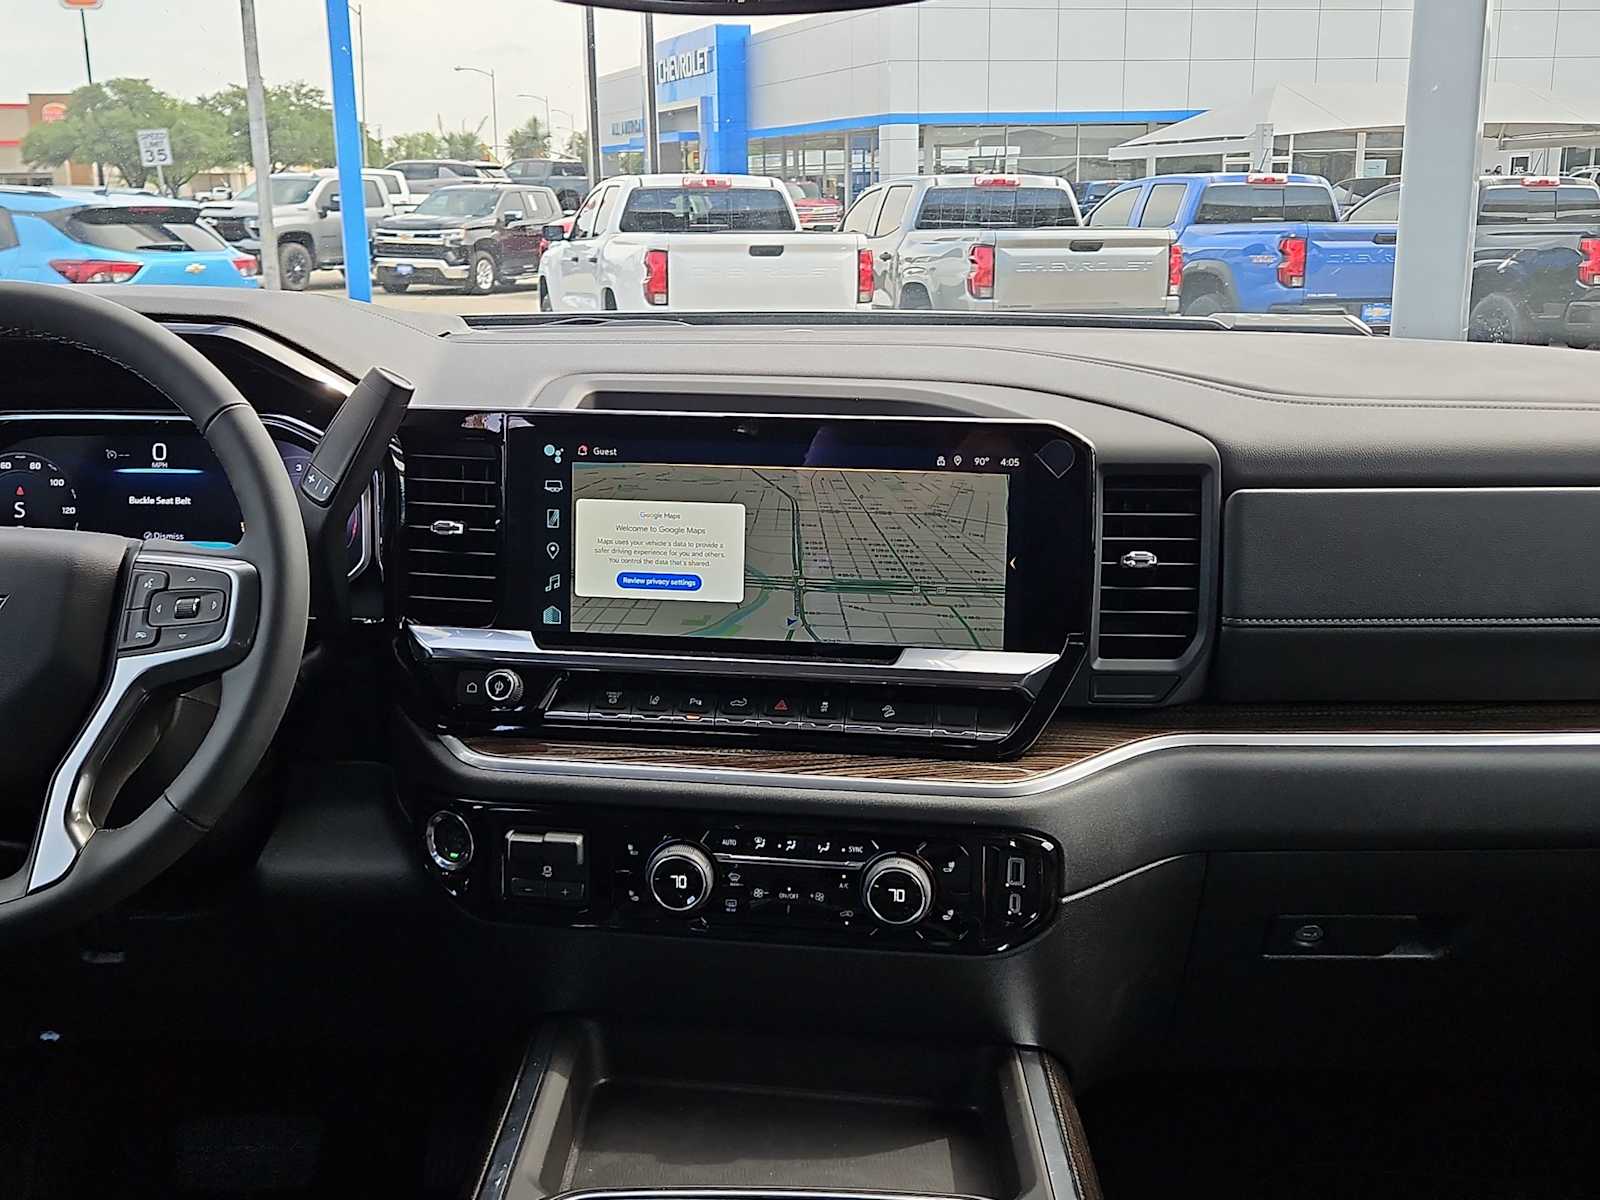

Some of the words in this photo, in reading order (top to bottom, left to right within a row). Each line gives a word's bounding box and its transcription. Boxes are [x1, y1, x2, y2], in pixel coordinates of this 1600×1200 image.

[657, 48, 708, 84] CHEVROLET
[145, 149, 168, 162] 35
[1015, 261, 1153, 272] CHEVROLET
[152, 443, 167, 461] 0
[593, 447, 617, 456] Guest
[30, 462, 41, 470] 80
[974, 457, 990, 466] 90°
[1000, 458, 1020, 467] 4:05
[50, 478, 64, 486] 100
[129, 496, 155, 505] Buckle
[156, 497, 173, 505] Seat
[174, 497, 191, 505] Belt
[14, 502, 26, 519] S
[640, 511, 662, 520] Google
[664, 512, 681, 520] Maps
[616, 524, 648, 533] Welcome
[659, 525, 685, 535] Google
[686, 527, 706, 535] Maps
[153, 532, 184, 541] Dismiss
[597, 537, 613, 546] Maps
[696, 541, 718, 549] provide
[594, 546, 609, 554] safer
[611, 547, 632, 555] driving
[623, 576, 646, 584] Review
[646, 577, 670, 587] privacy
[671, 578, 696, 588] settings
[670, 875, 687, 889] 70
[888, 888, 905, 902] 70
